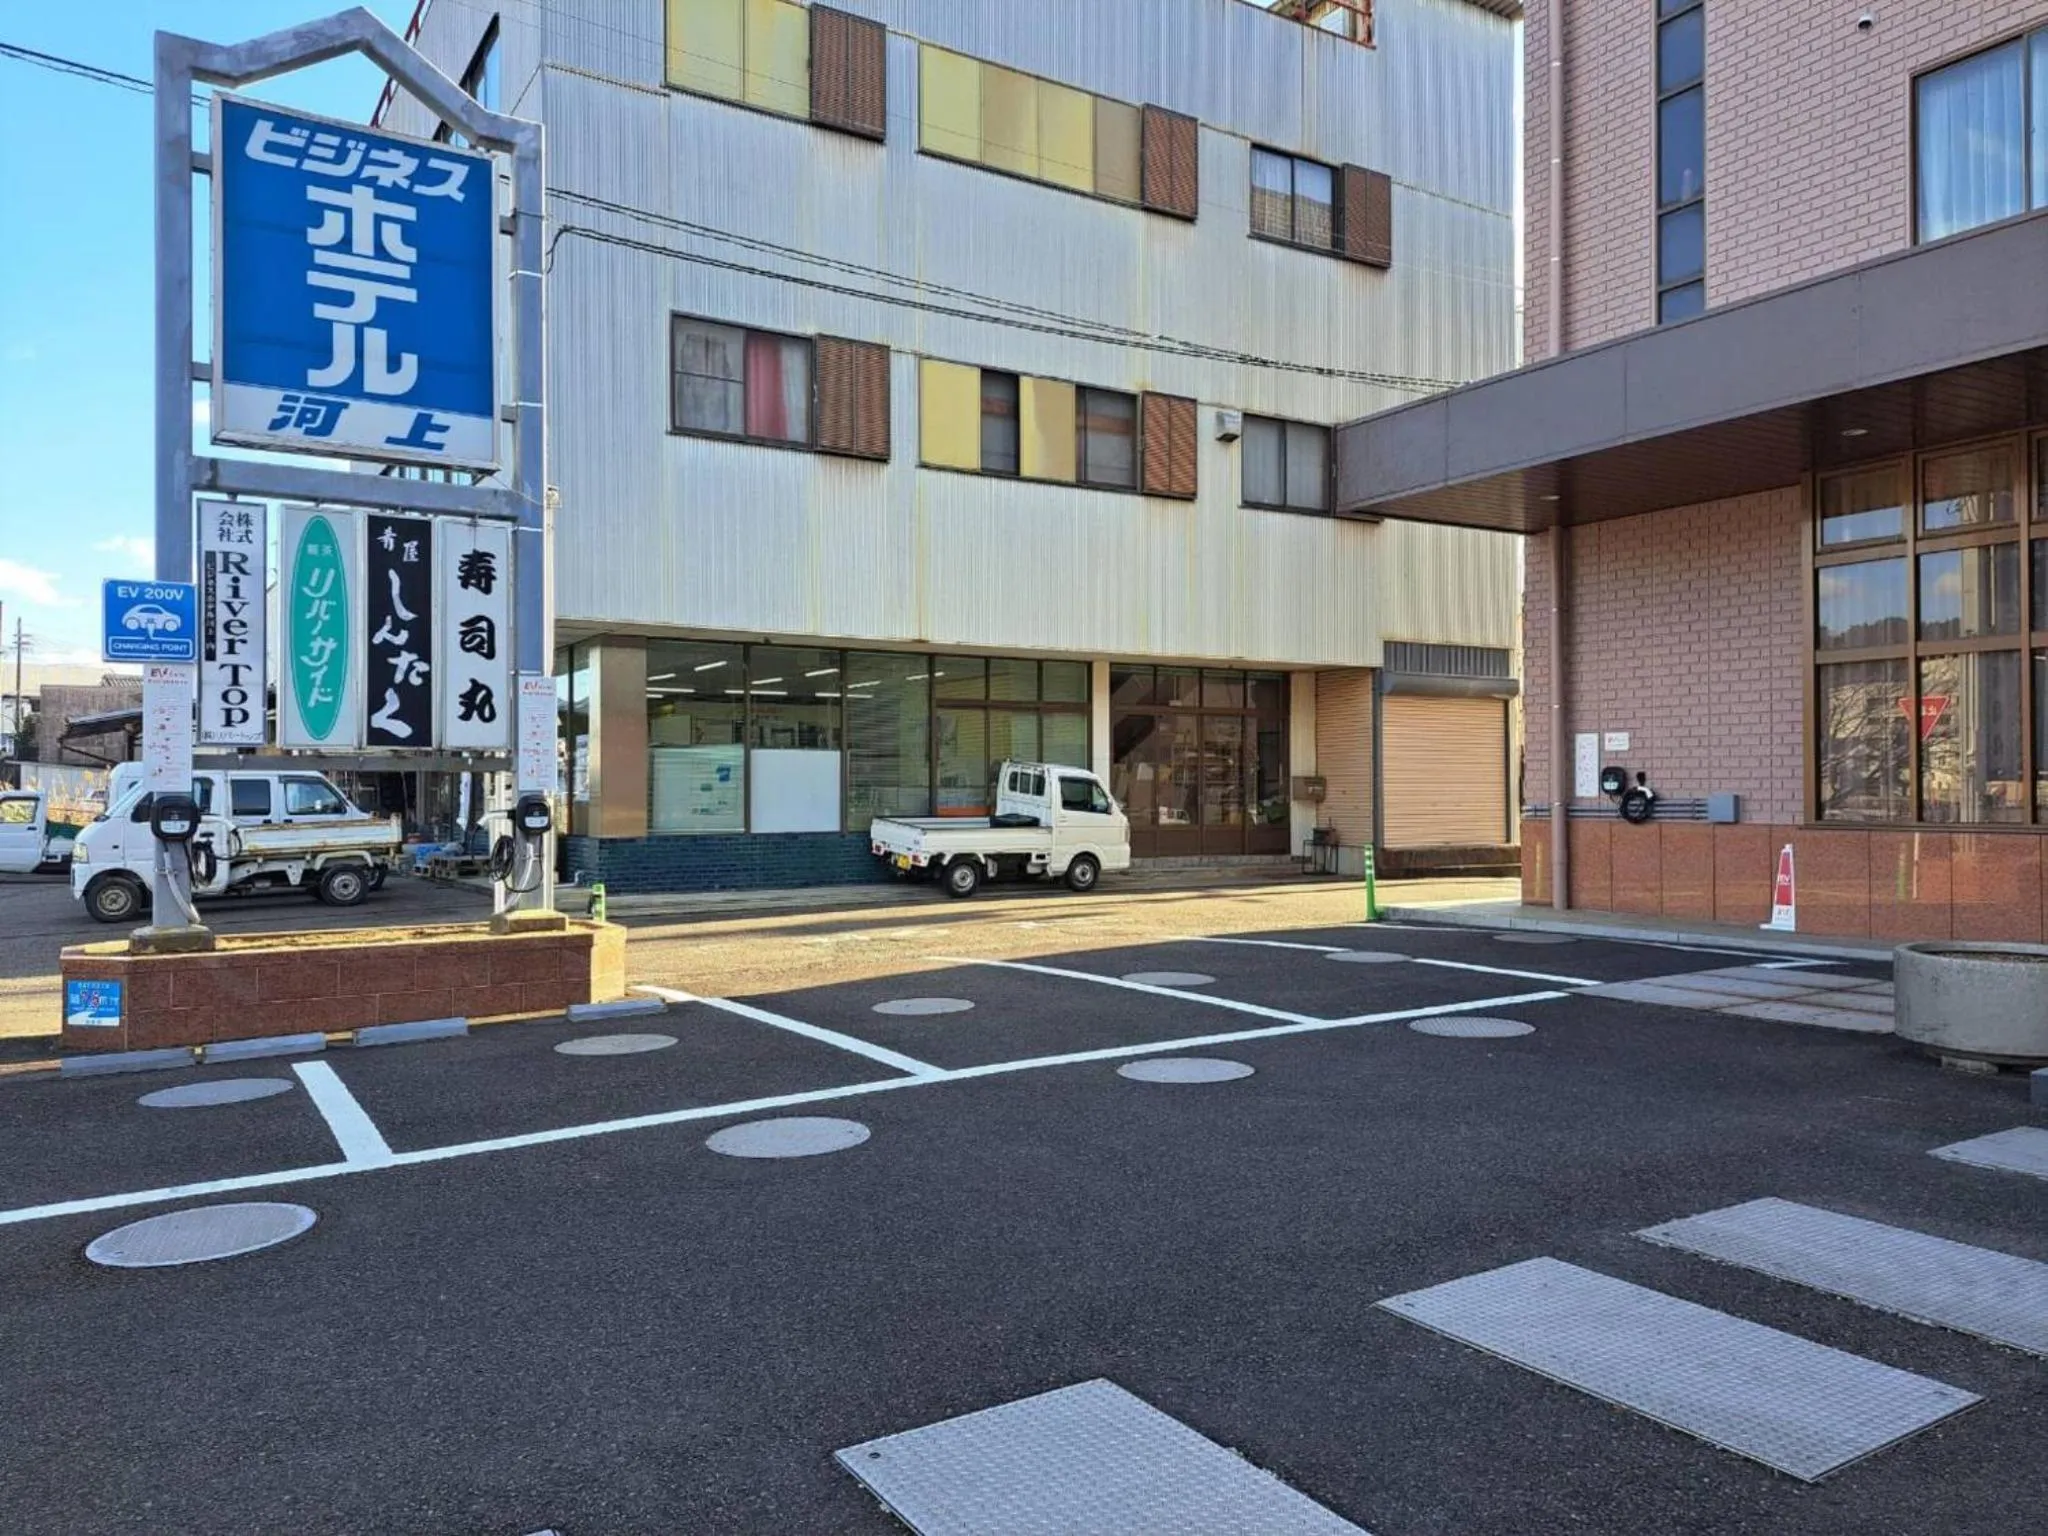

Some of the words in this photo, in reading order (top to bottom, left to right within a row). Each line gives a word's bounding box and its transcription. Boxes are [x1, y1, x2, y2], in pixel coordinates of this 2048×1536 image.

[244, 119, 471, 204] ビジネス
[306, 183, 418, 396] ホテル
[267, 393, 450, 450] 河上
[112, 641, 160, 651] CHARGING
[161, 643, 188, 653] POINT
[117, 586, 140, 599] EV
[144, 587, 184, 601] 200V
[301, 567, 338, 708] リバーサイド
[457, 549, 498, 724] 寿司丸
[370, 568, 431, 739] しんたく
